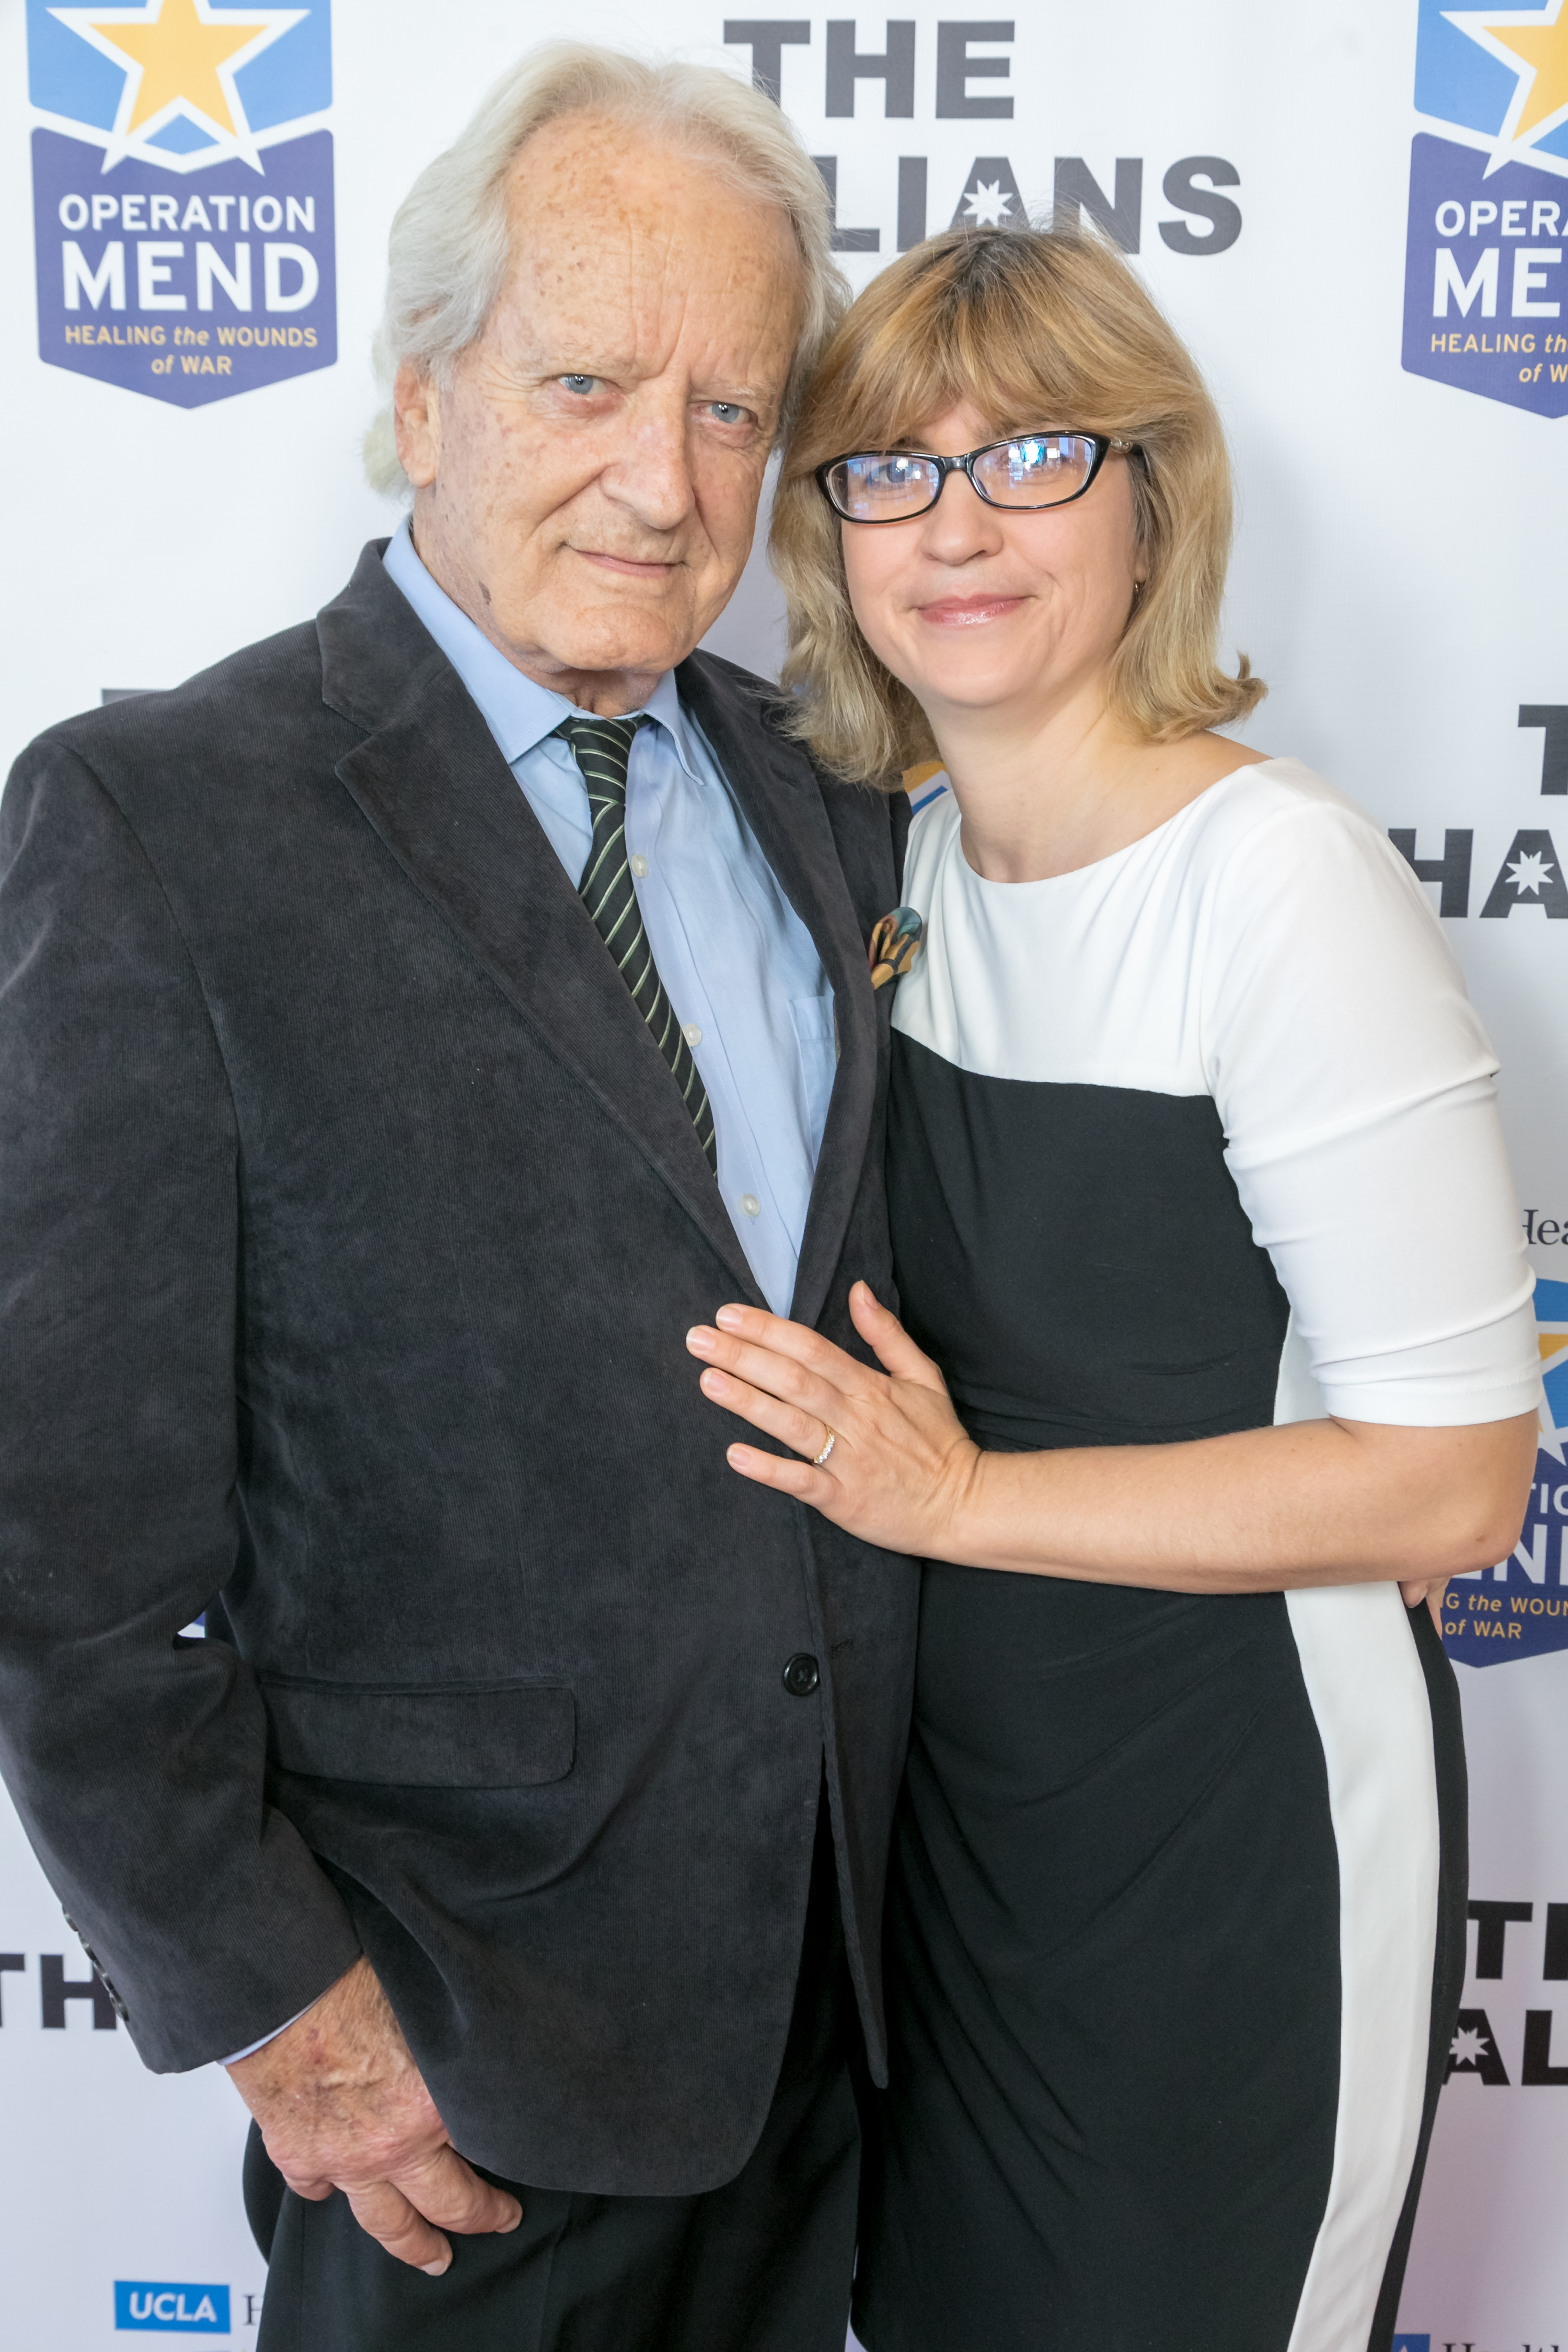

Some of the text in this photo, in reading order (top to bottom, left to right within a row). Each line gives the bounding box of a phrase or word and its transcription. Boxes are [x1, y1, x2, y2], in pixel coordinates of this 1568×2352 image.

[723, 19, 1015, 119] THE
[59, 194, 316, 233] OPERATION
[1435, 200, 1568, 237] OPER
[62, 240, 320, 313] MEND
[1433, 247, 1563, 318] ME
[65, 325, 319, 348] HEALING the WOUNDS
[1431, 333, 1568, 353] HEALING th
[151, 354, 233, 375] of WAR
[1519, 363, 1543, 383] of
[1468, 1595, 1502, 1612] the
[1445, 1619, 1522, 1639] of WAR
[129, 2291, 217, 2322] UCLA
